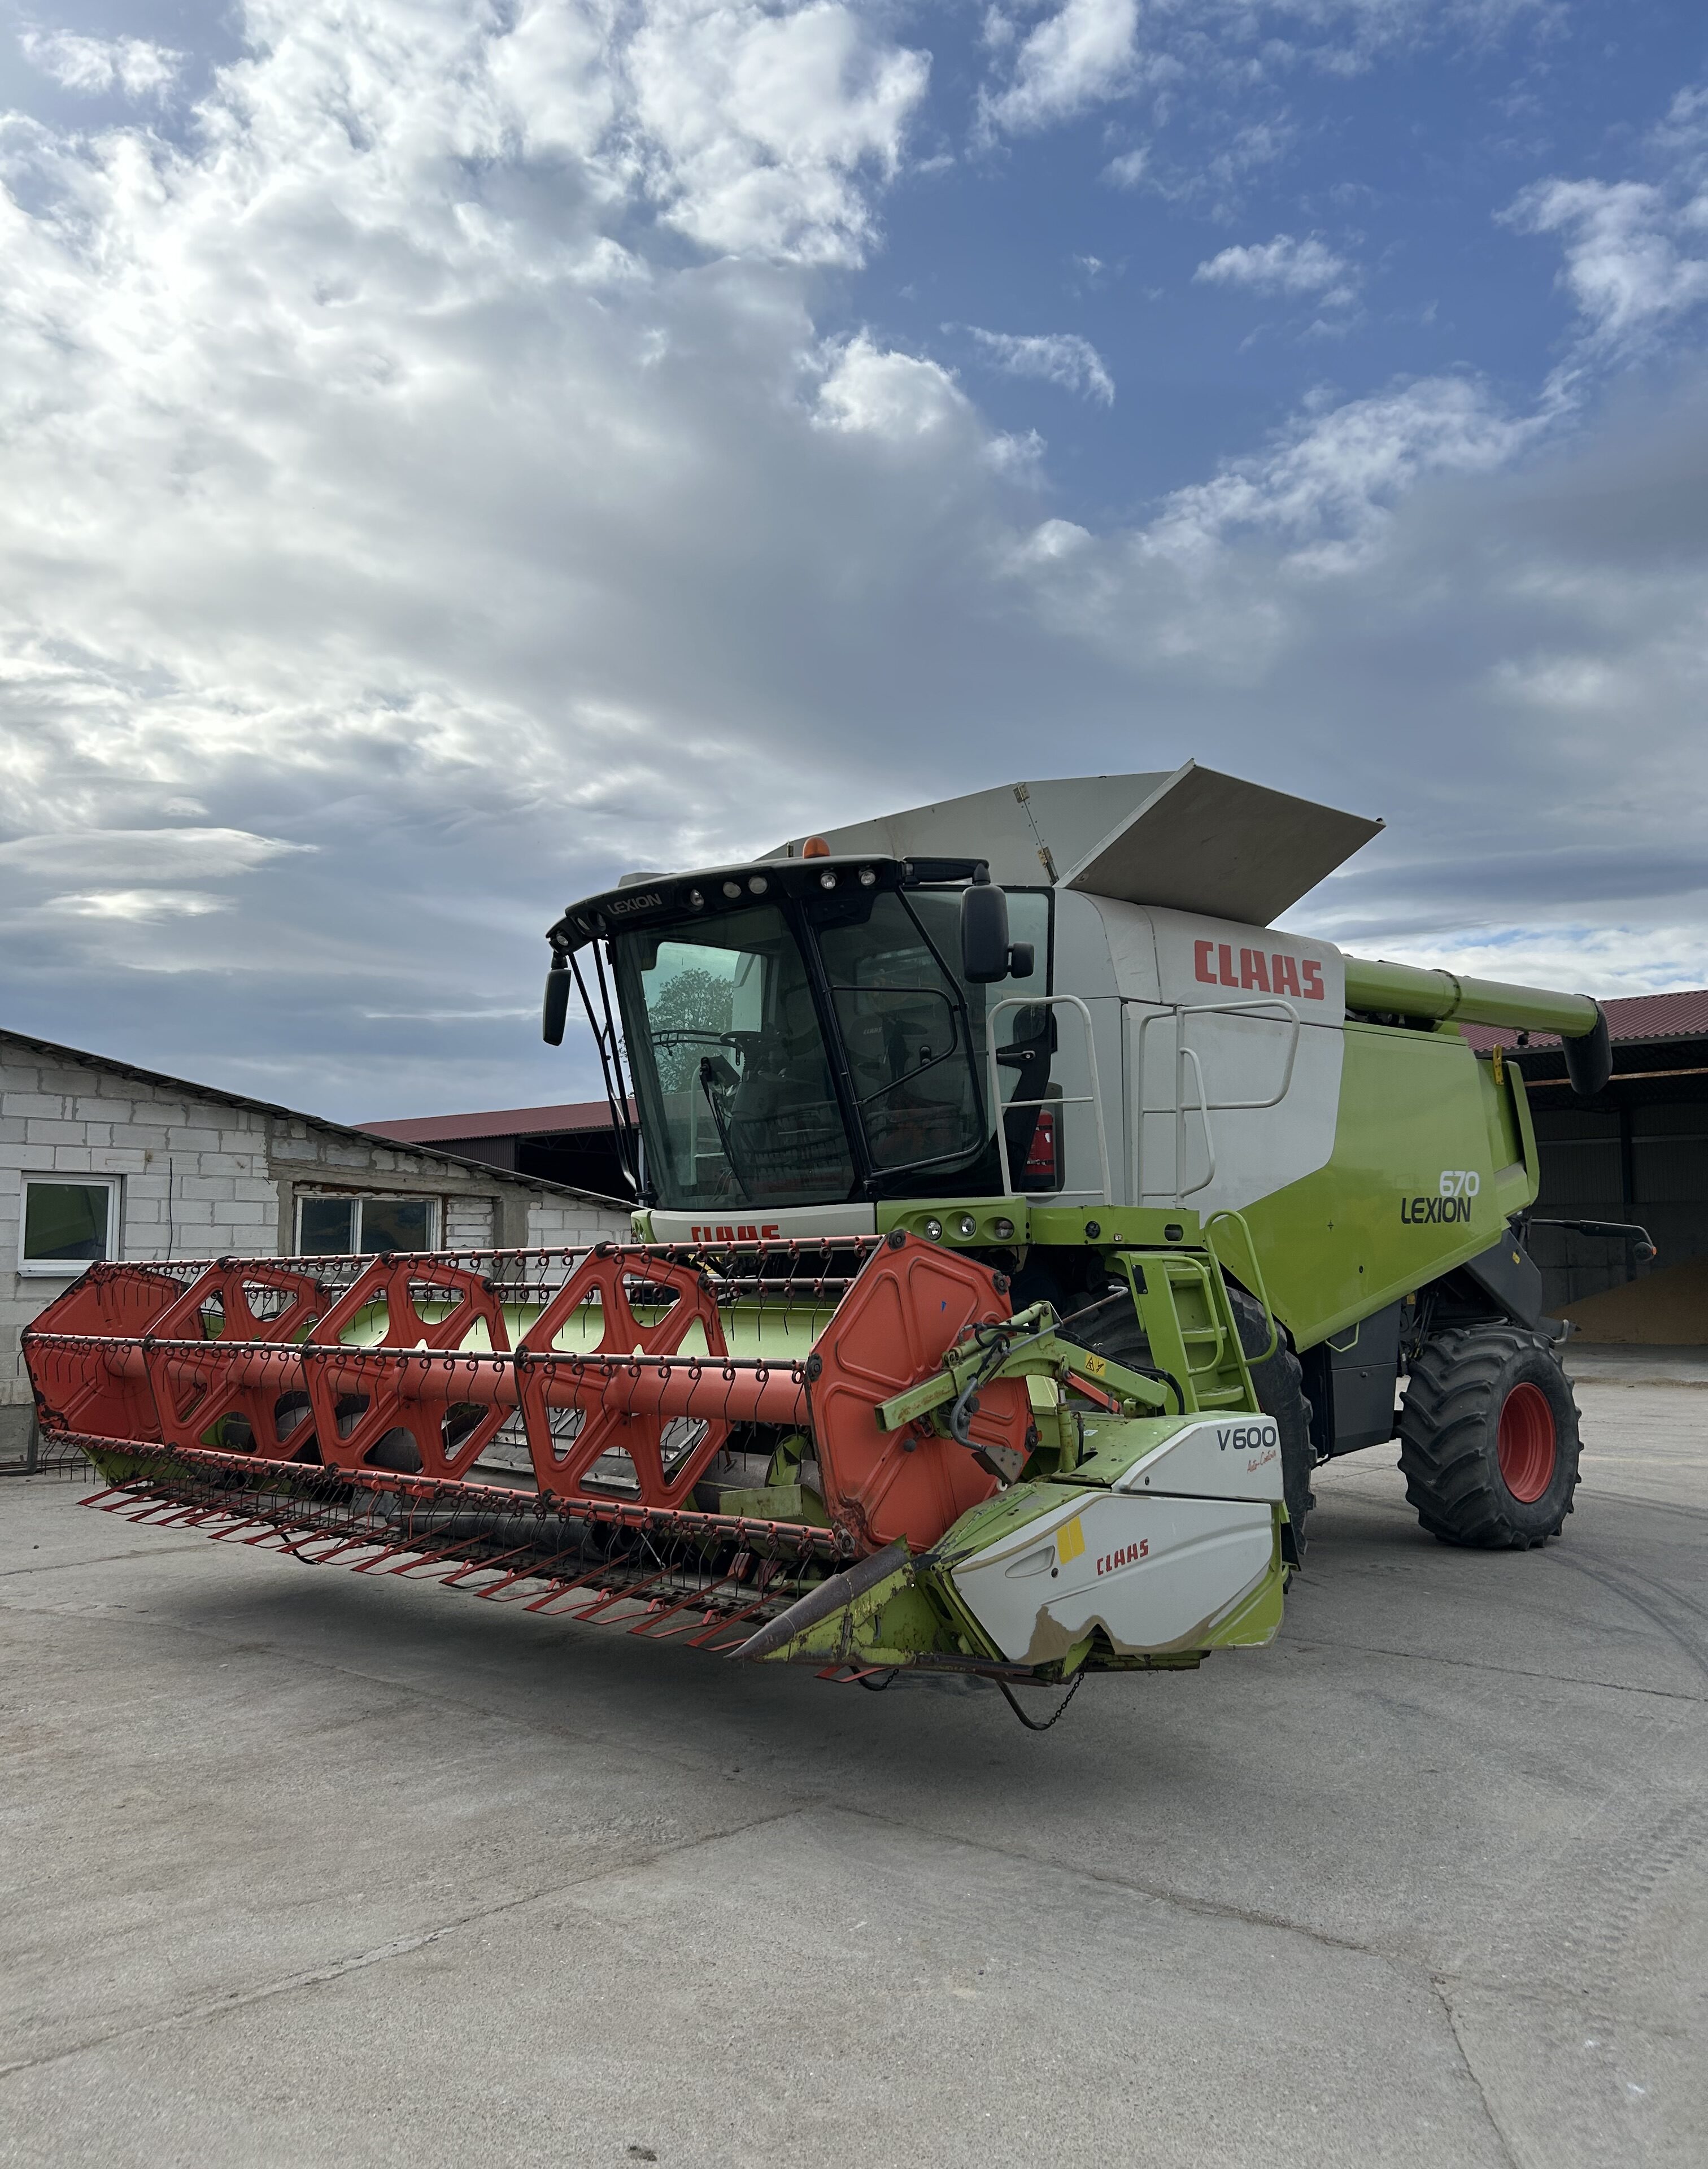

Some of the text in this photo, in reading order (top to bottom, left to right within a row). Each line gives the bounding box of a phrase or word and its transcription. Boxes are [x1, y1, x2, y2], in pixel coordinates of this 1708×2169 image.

[607, 894, 663, 914] LEXION
[1195, 940, 1324, 1000] CLAAS
[1440, 1170, 1480, 1196] 670
[1401, 1197, 1471, 1224] LEXION
[1217, 1426, 1276, 1451] V600
[1097, 1538, 1148, 1576] CLAAS
